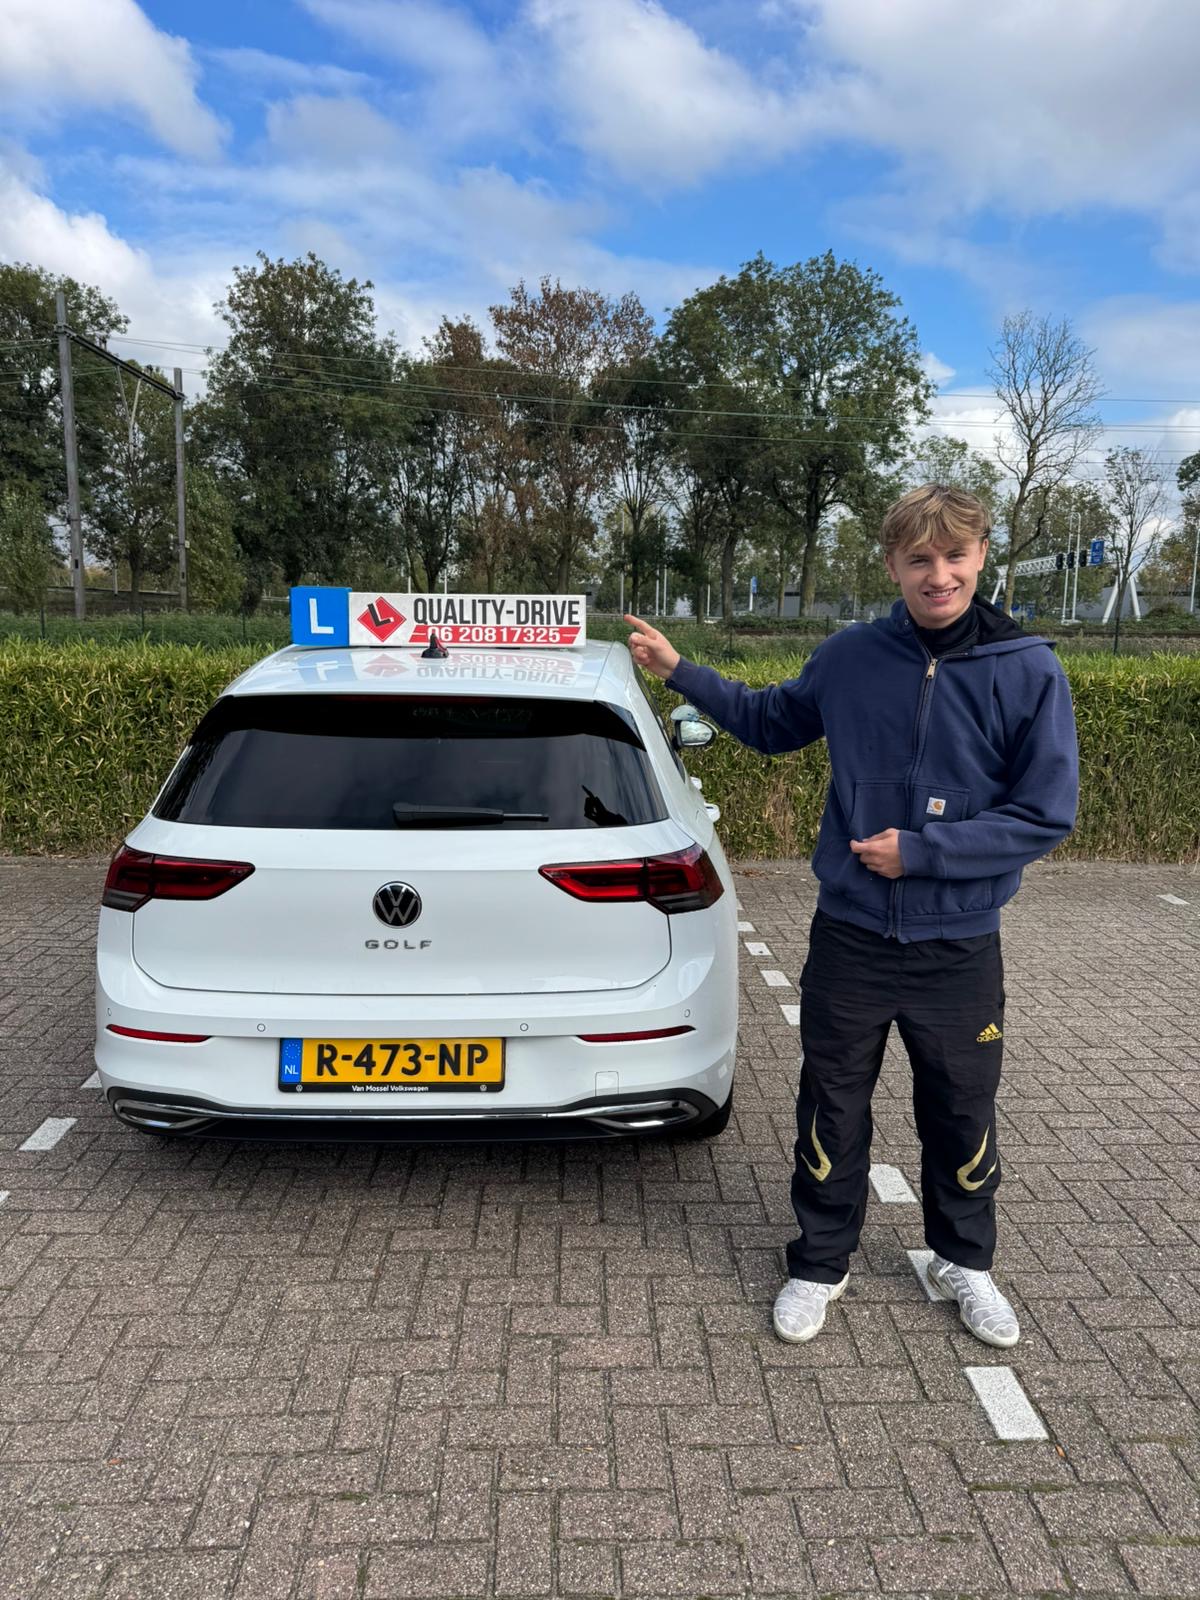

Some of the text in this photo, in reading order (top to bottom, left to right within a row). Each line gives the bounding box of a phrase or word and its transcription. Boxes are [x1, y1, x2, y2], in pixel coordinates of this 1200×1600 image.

[309, 598, 335, 634] L
[413, 597, 580, 626] QUALITY-DRIVE
[427, 626, 561, 643] 06 20817325
[365, 939, 432, 950] GOLF
[316, 1043, 489, 1077] R-473-NP
[284, 1064, 299, 1075] NL
[351, 1084, 429, 1093] Van Mossel Volkswagen
